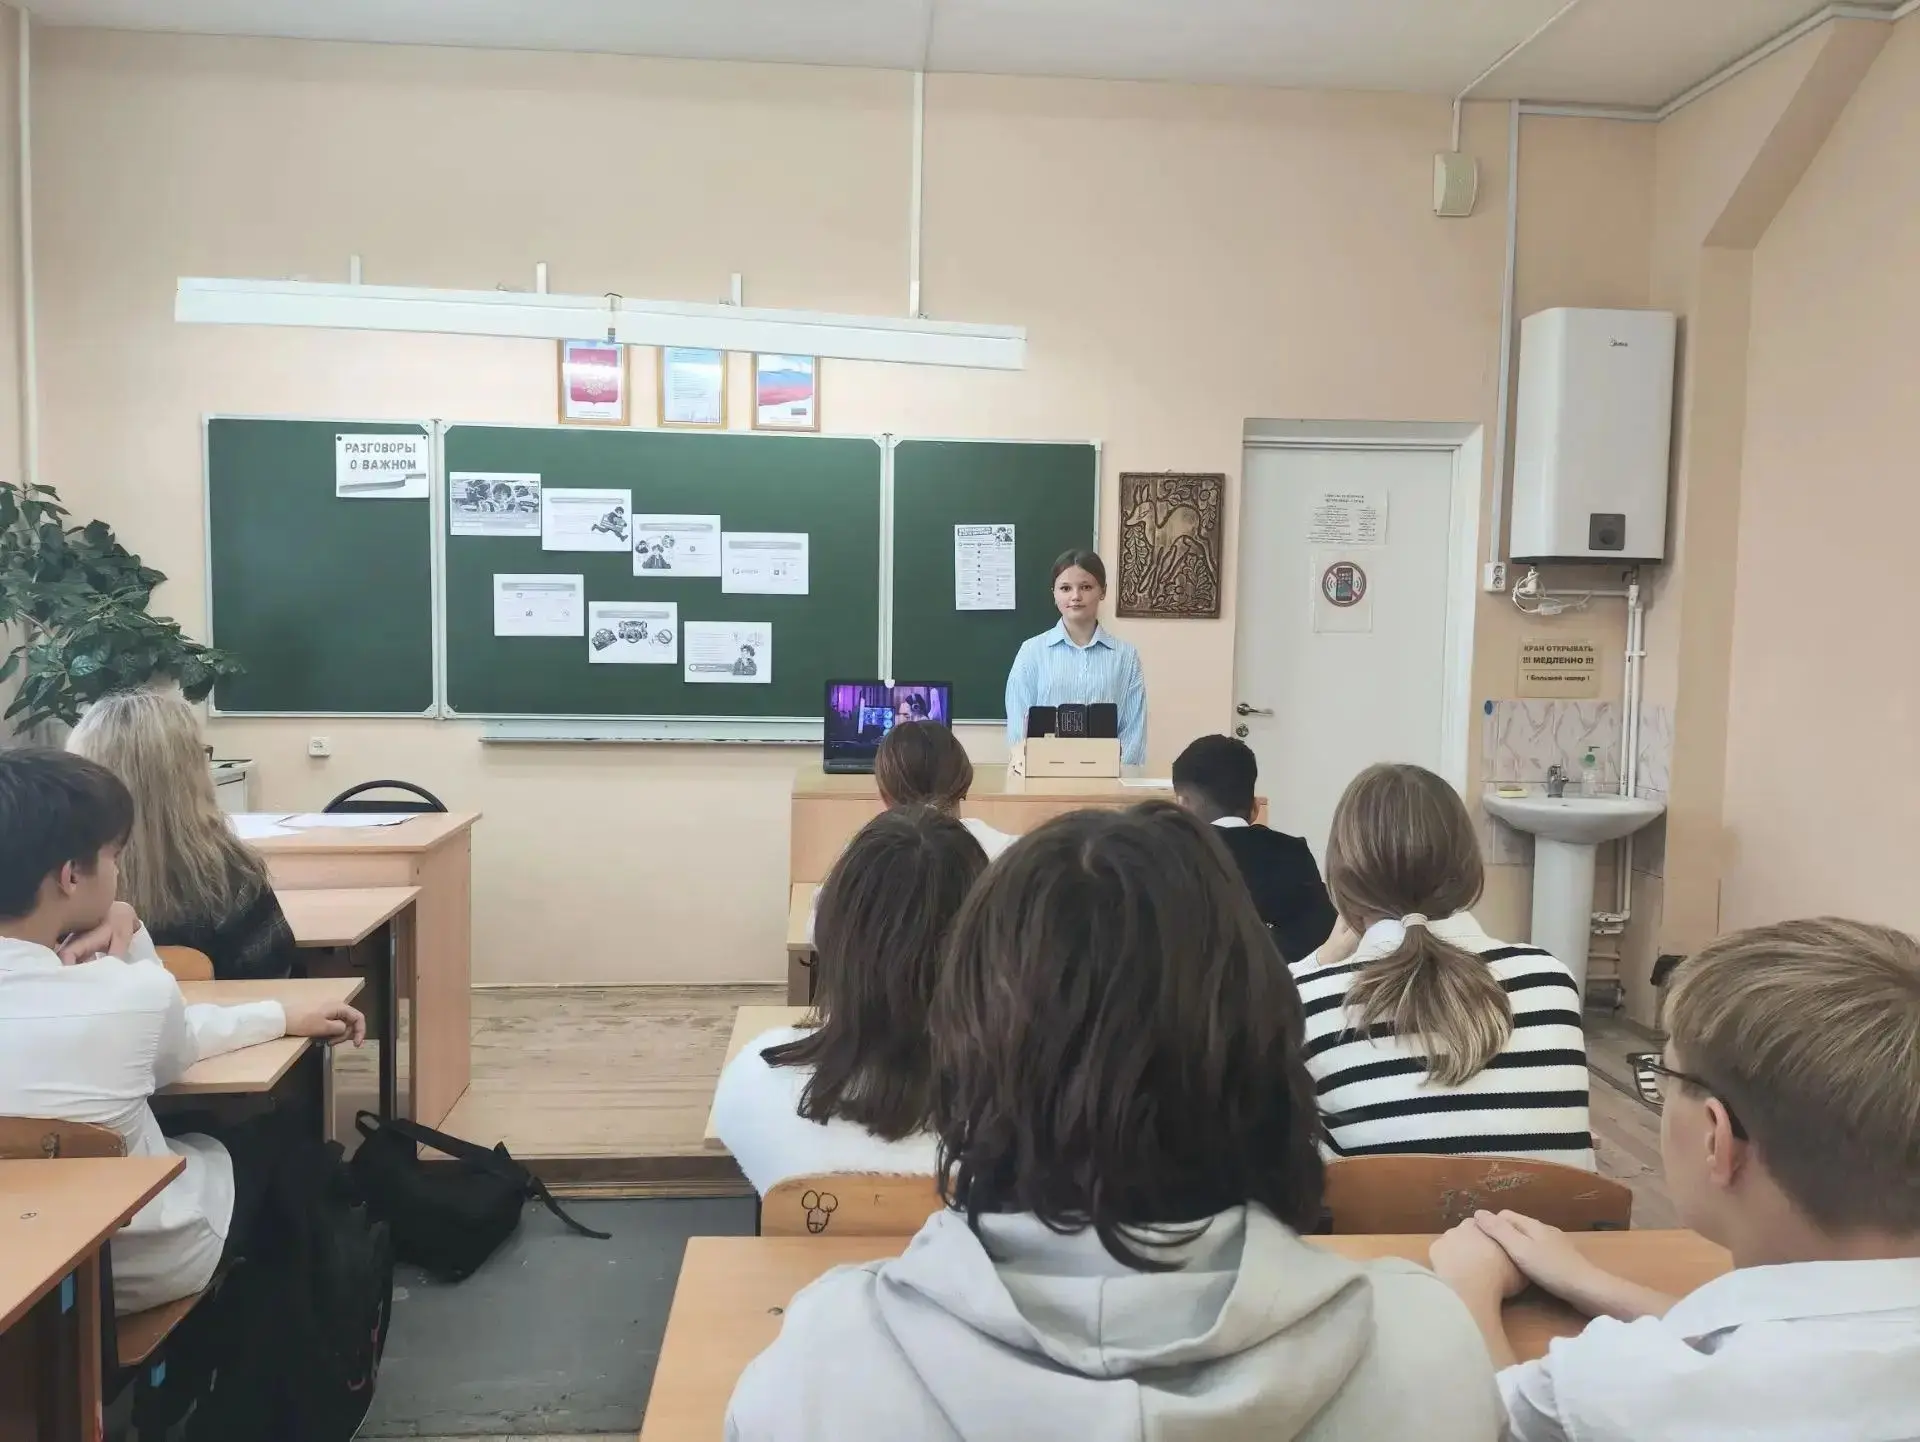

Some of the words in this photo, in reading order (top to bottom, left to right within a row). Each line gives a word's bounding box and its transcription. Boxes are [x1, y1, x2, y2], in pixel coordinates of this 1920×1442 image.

[345, 443, 416, 453] РАЗГОВОРЫ
[350, 460, 357, 470] О
[362, 460, 416, 470] ВАЖНОМ
[1533, 656, 1583, 665] МЕДЛЕННО
